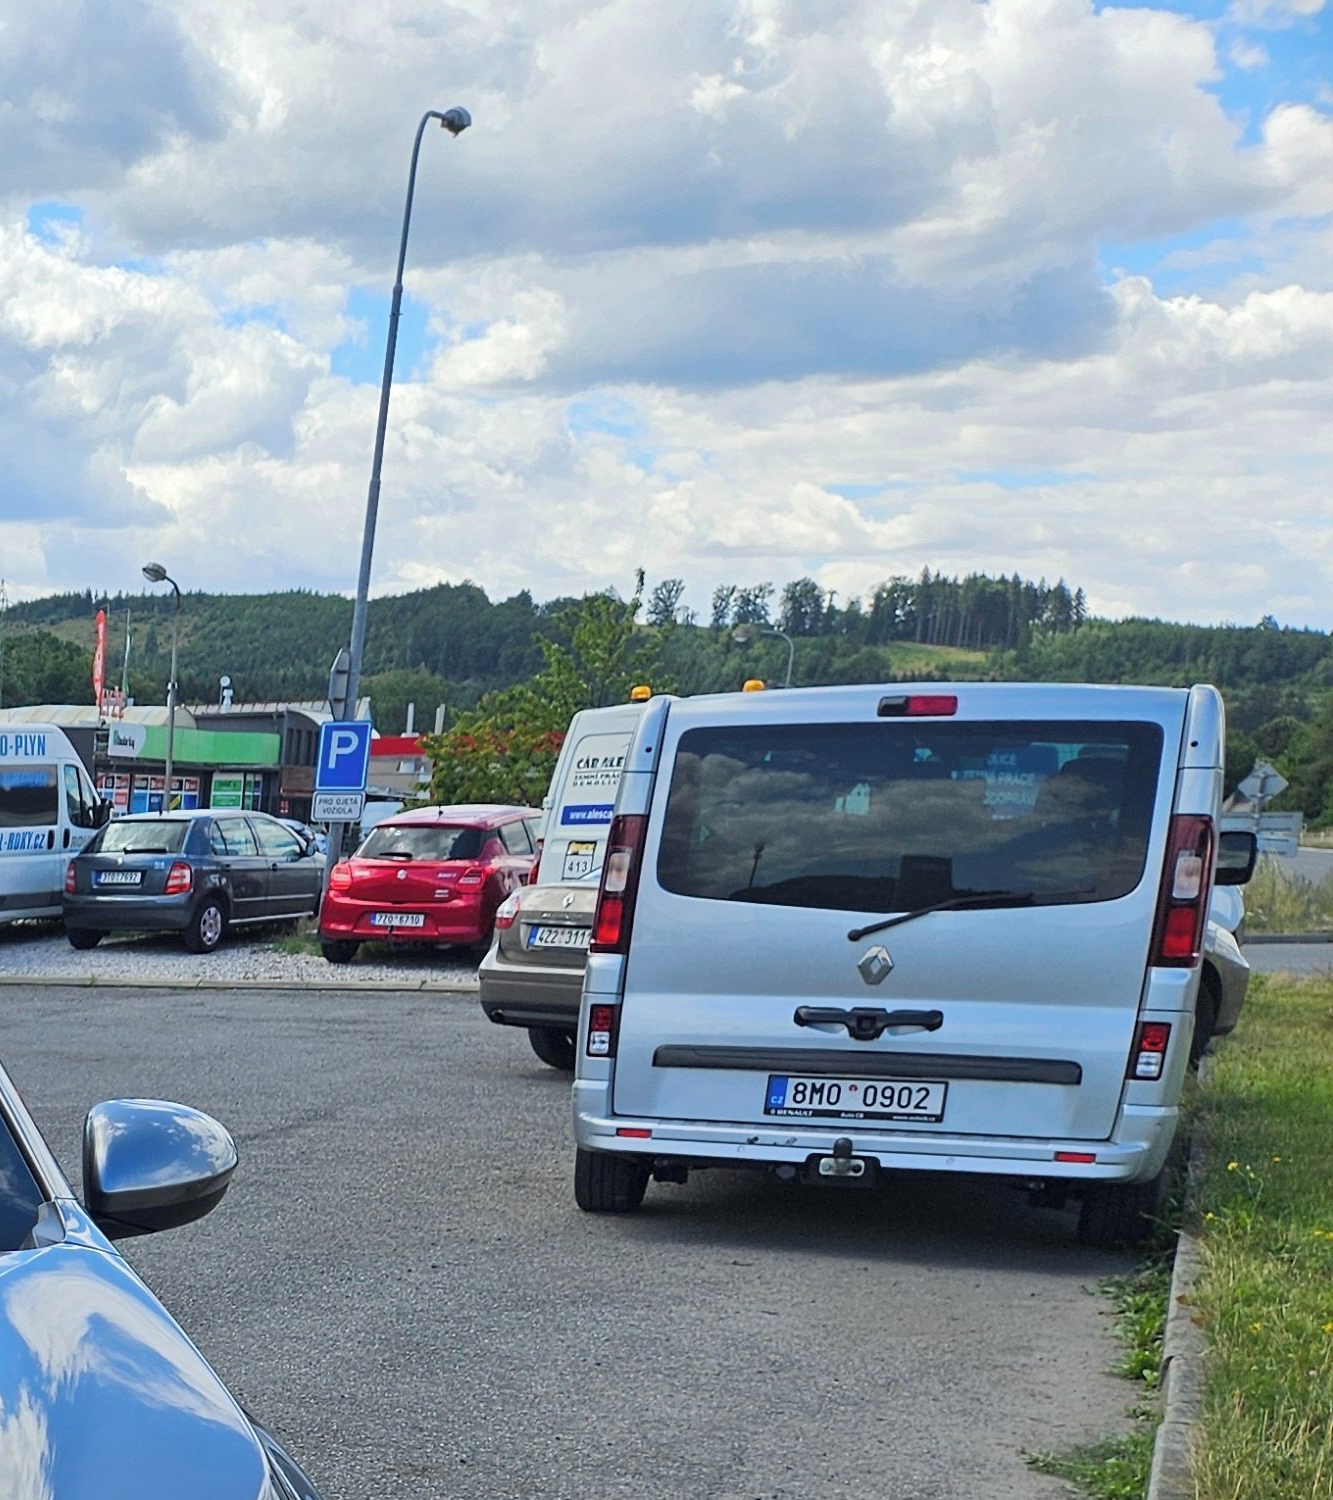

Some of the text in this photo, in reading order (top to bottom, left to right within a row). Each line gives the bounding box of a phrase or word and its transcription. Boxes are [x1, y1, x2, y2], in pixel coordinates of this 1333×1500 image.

[328, 730, 359, 769] P
[567, 860, 588, 873] 413
[538, 929, 559, 944] 4Z2
[770, 1095, 784, 1104] CZ
[792, 1081, 931, 1110] 8M0 0902
[776, 1109, 813, 1117] RENAULT
